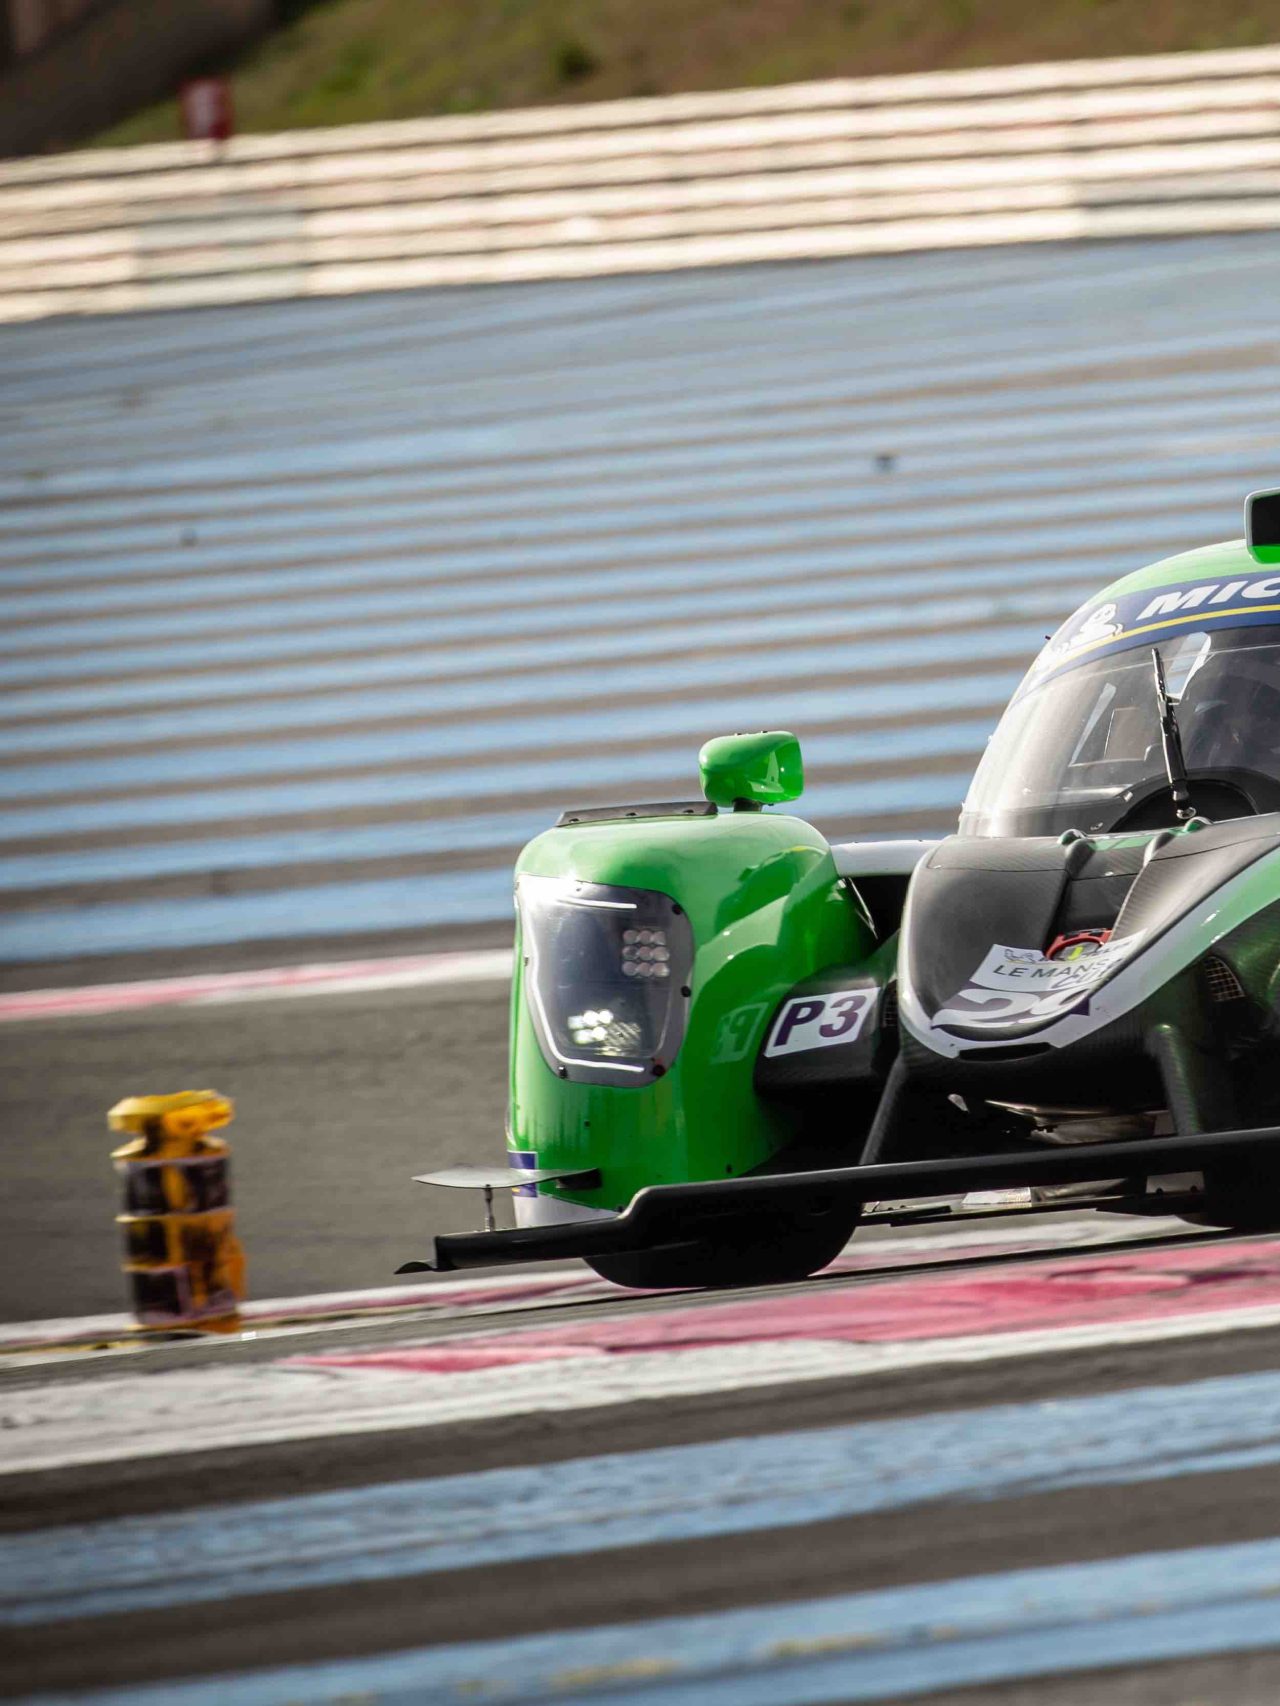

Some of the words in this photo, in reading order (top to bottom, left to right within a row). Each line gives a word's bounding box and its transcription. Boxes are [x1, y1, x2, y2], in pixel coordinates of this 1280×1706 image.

[993, 964, 1028, 977] LE
[1031, 958, 1110, 978] MANS
[773, 995, 867, 1048] P3
